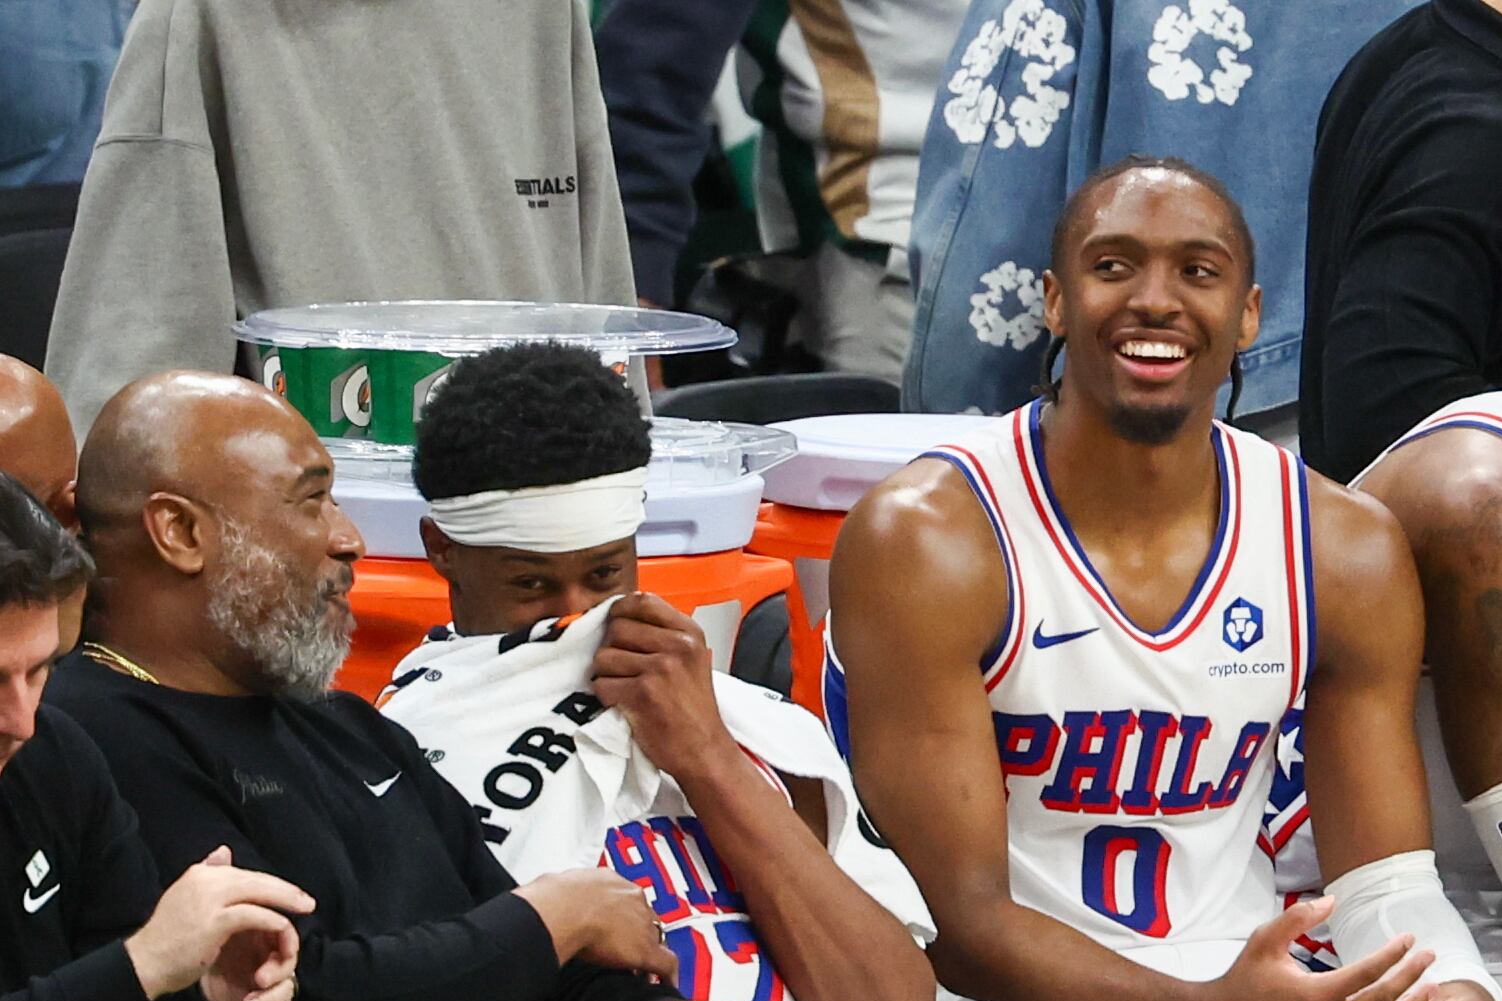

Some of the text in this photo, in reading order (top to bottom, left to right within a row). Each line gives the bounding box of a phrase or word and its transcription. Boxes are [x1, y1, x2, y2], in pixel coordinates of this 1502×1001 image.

[1208, 661, 1285, 678] crypto.com
[992, 708, 1270, 817] PHILA
[1081, 824, 1172, 938] 0
